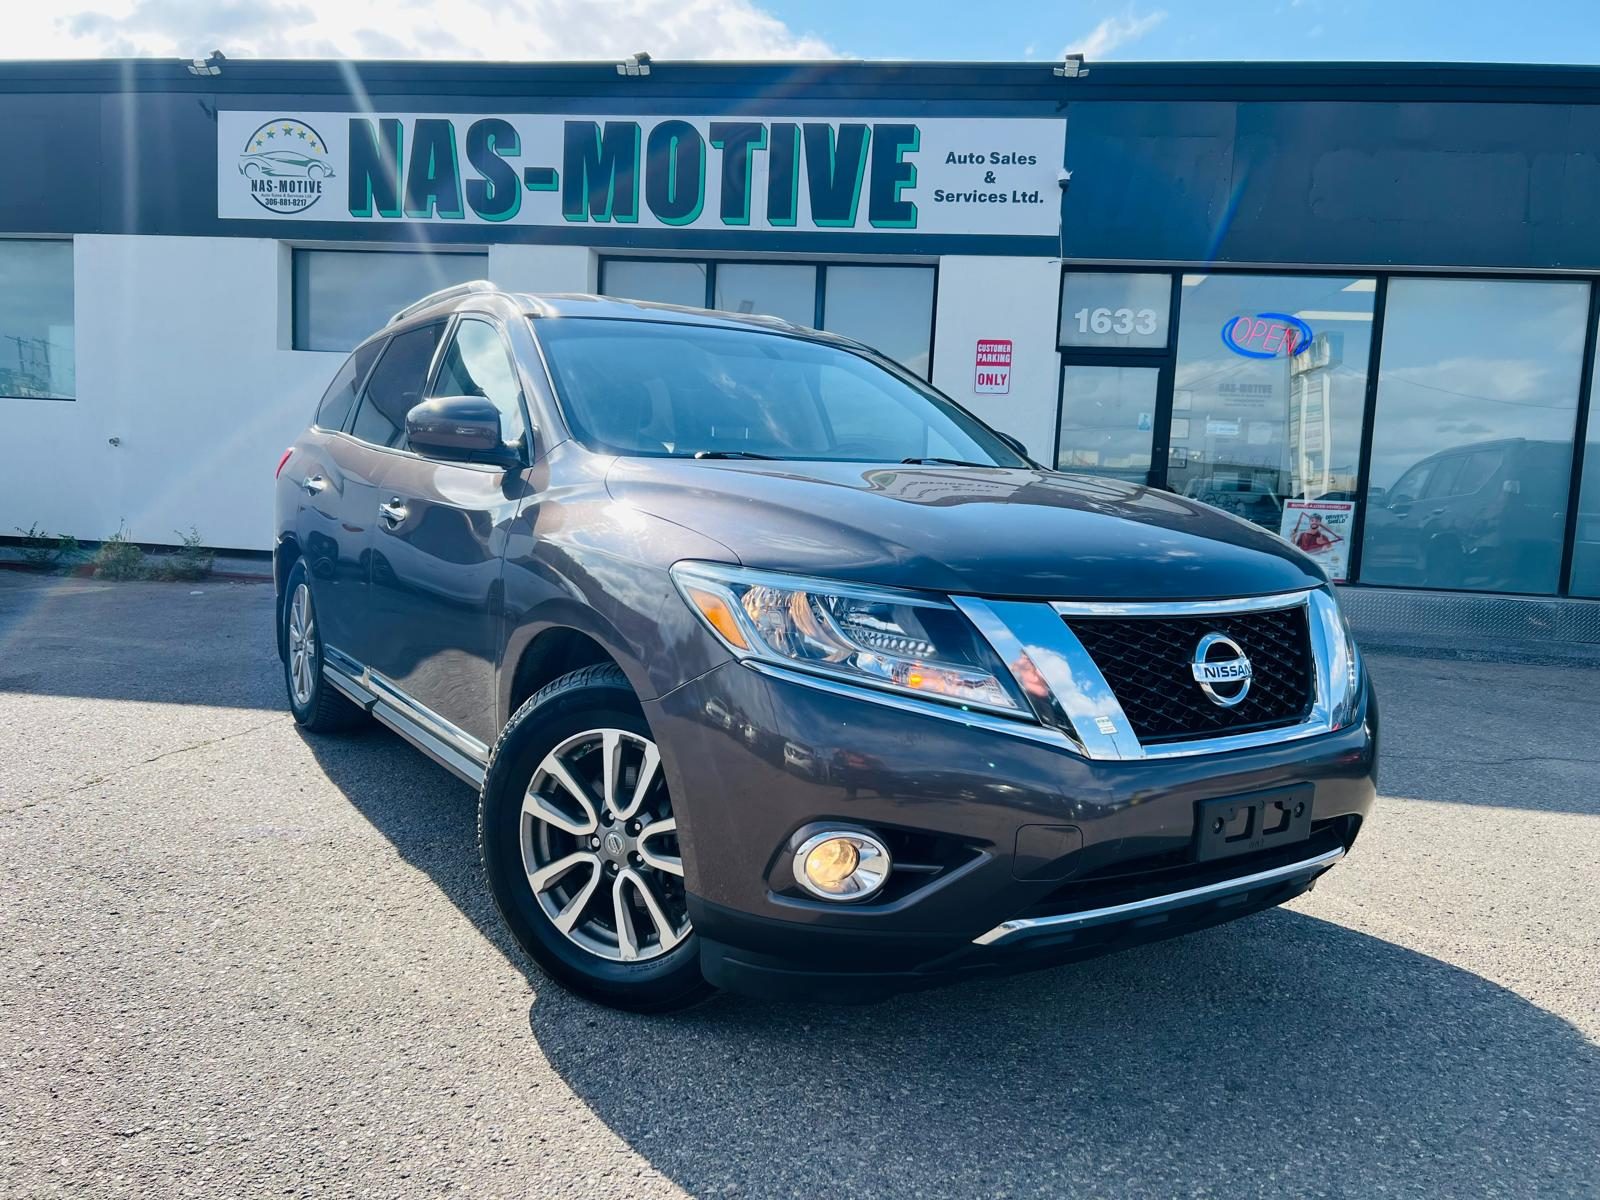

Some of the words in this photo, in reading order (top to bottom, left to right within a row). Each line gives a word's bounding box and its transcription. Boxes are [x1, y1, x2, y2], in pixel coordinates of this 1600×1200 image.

[945, 151, 985, 165] Auto
[989, 151, 1037, 165] Sales
[348, 117, 921, 229] NAS-MOTIVE
[984, 170, 996, 184] &
[251, 179, 322, 193] NAS-MOTIVE
[934, 189, 1008, 203] Services
[1012, 190, 1044, 204] Ltd.
[1074, 307, 1157, 335] 1633
[1231, 316, 1300, 355] OPEN
[977, 344, 1011, 353] CUSTOMER
[977, 353, 1011, 363] PARKING
[977, 372, 1007, 386] ONLY
[1203, 663, 1252, 679] NISSAN
